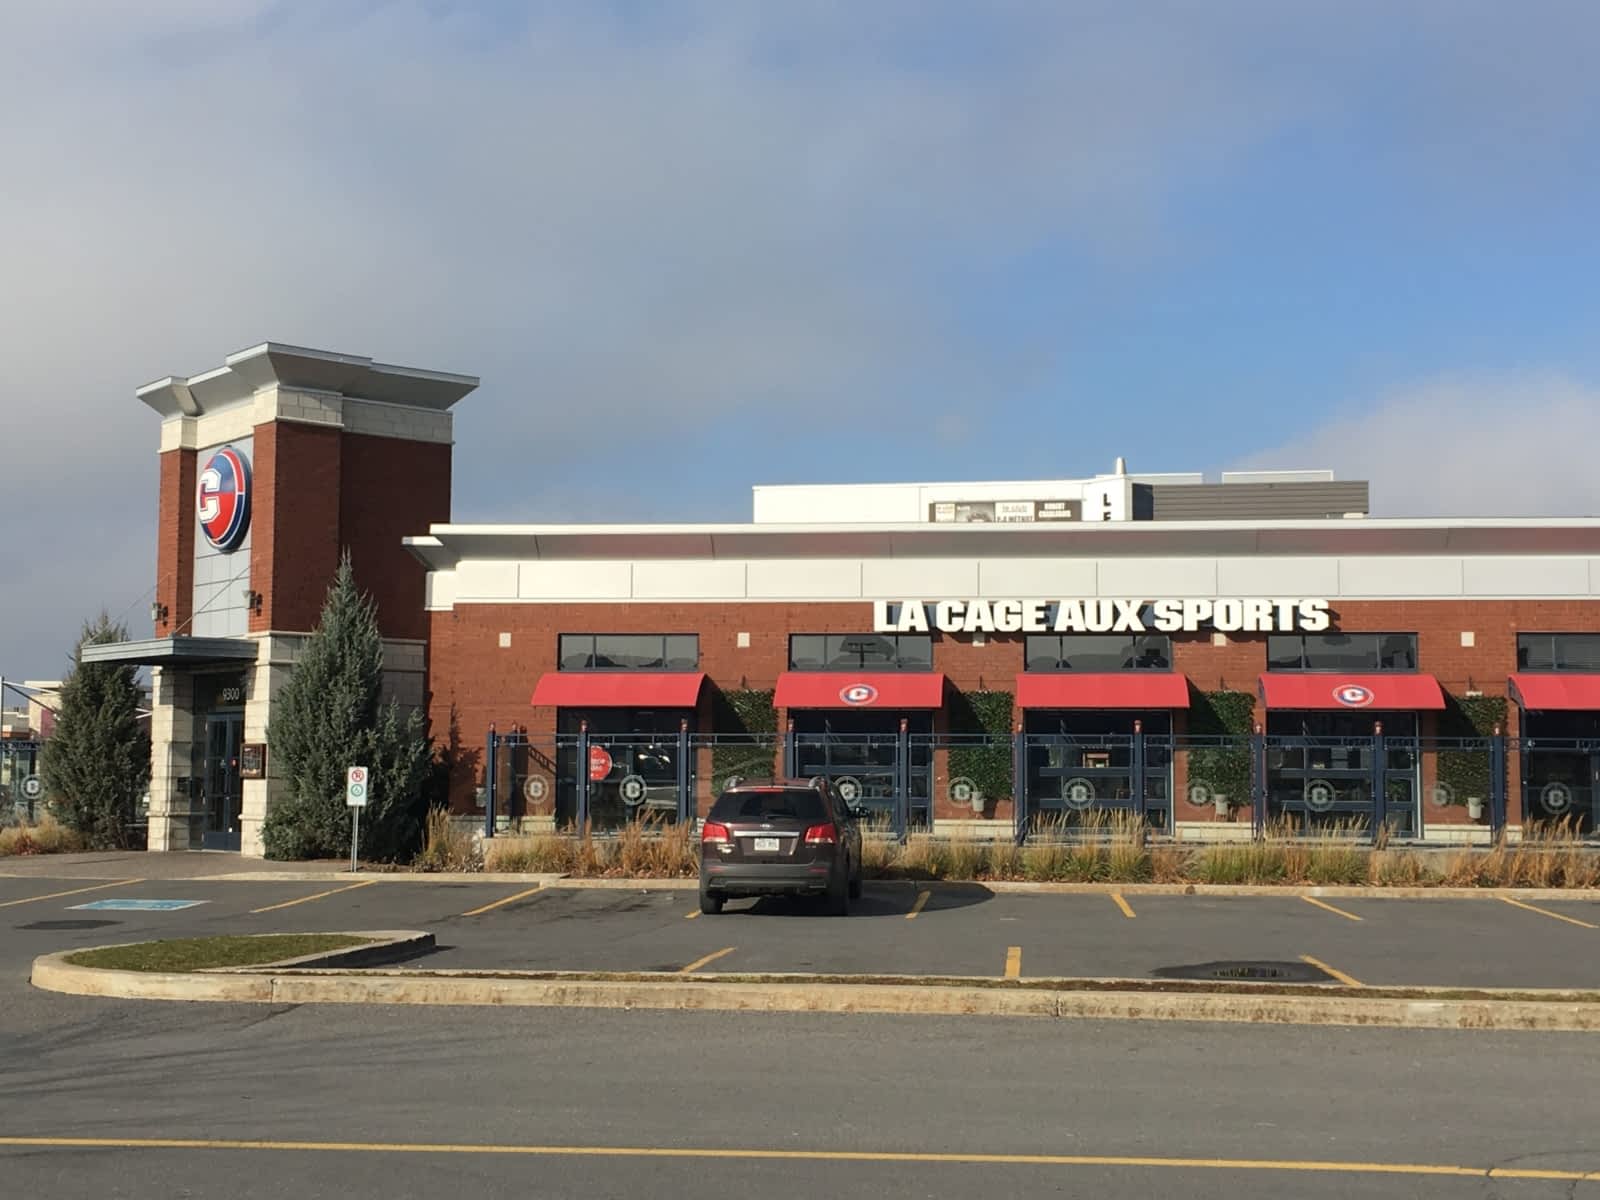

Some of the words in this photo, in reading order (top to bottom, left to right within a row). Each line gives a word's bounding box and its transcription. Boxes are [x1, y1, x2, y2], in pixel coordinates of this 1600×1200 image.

[874, 600, 929, 632] LA
[936, 600, 1047, 632] CAGE
[1054, 600, 1146, 632] AUX
[1154, 600, 1329, 632] SPORTS
